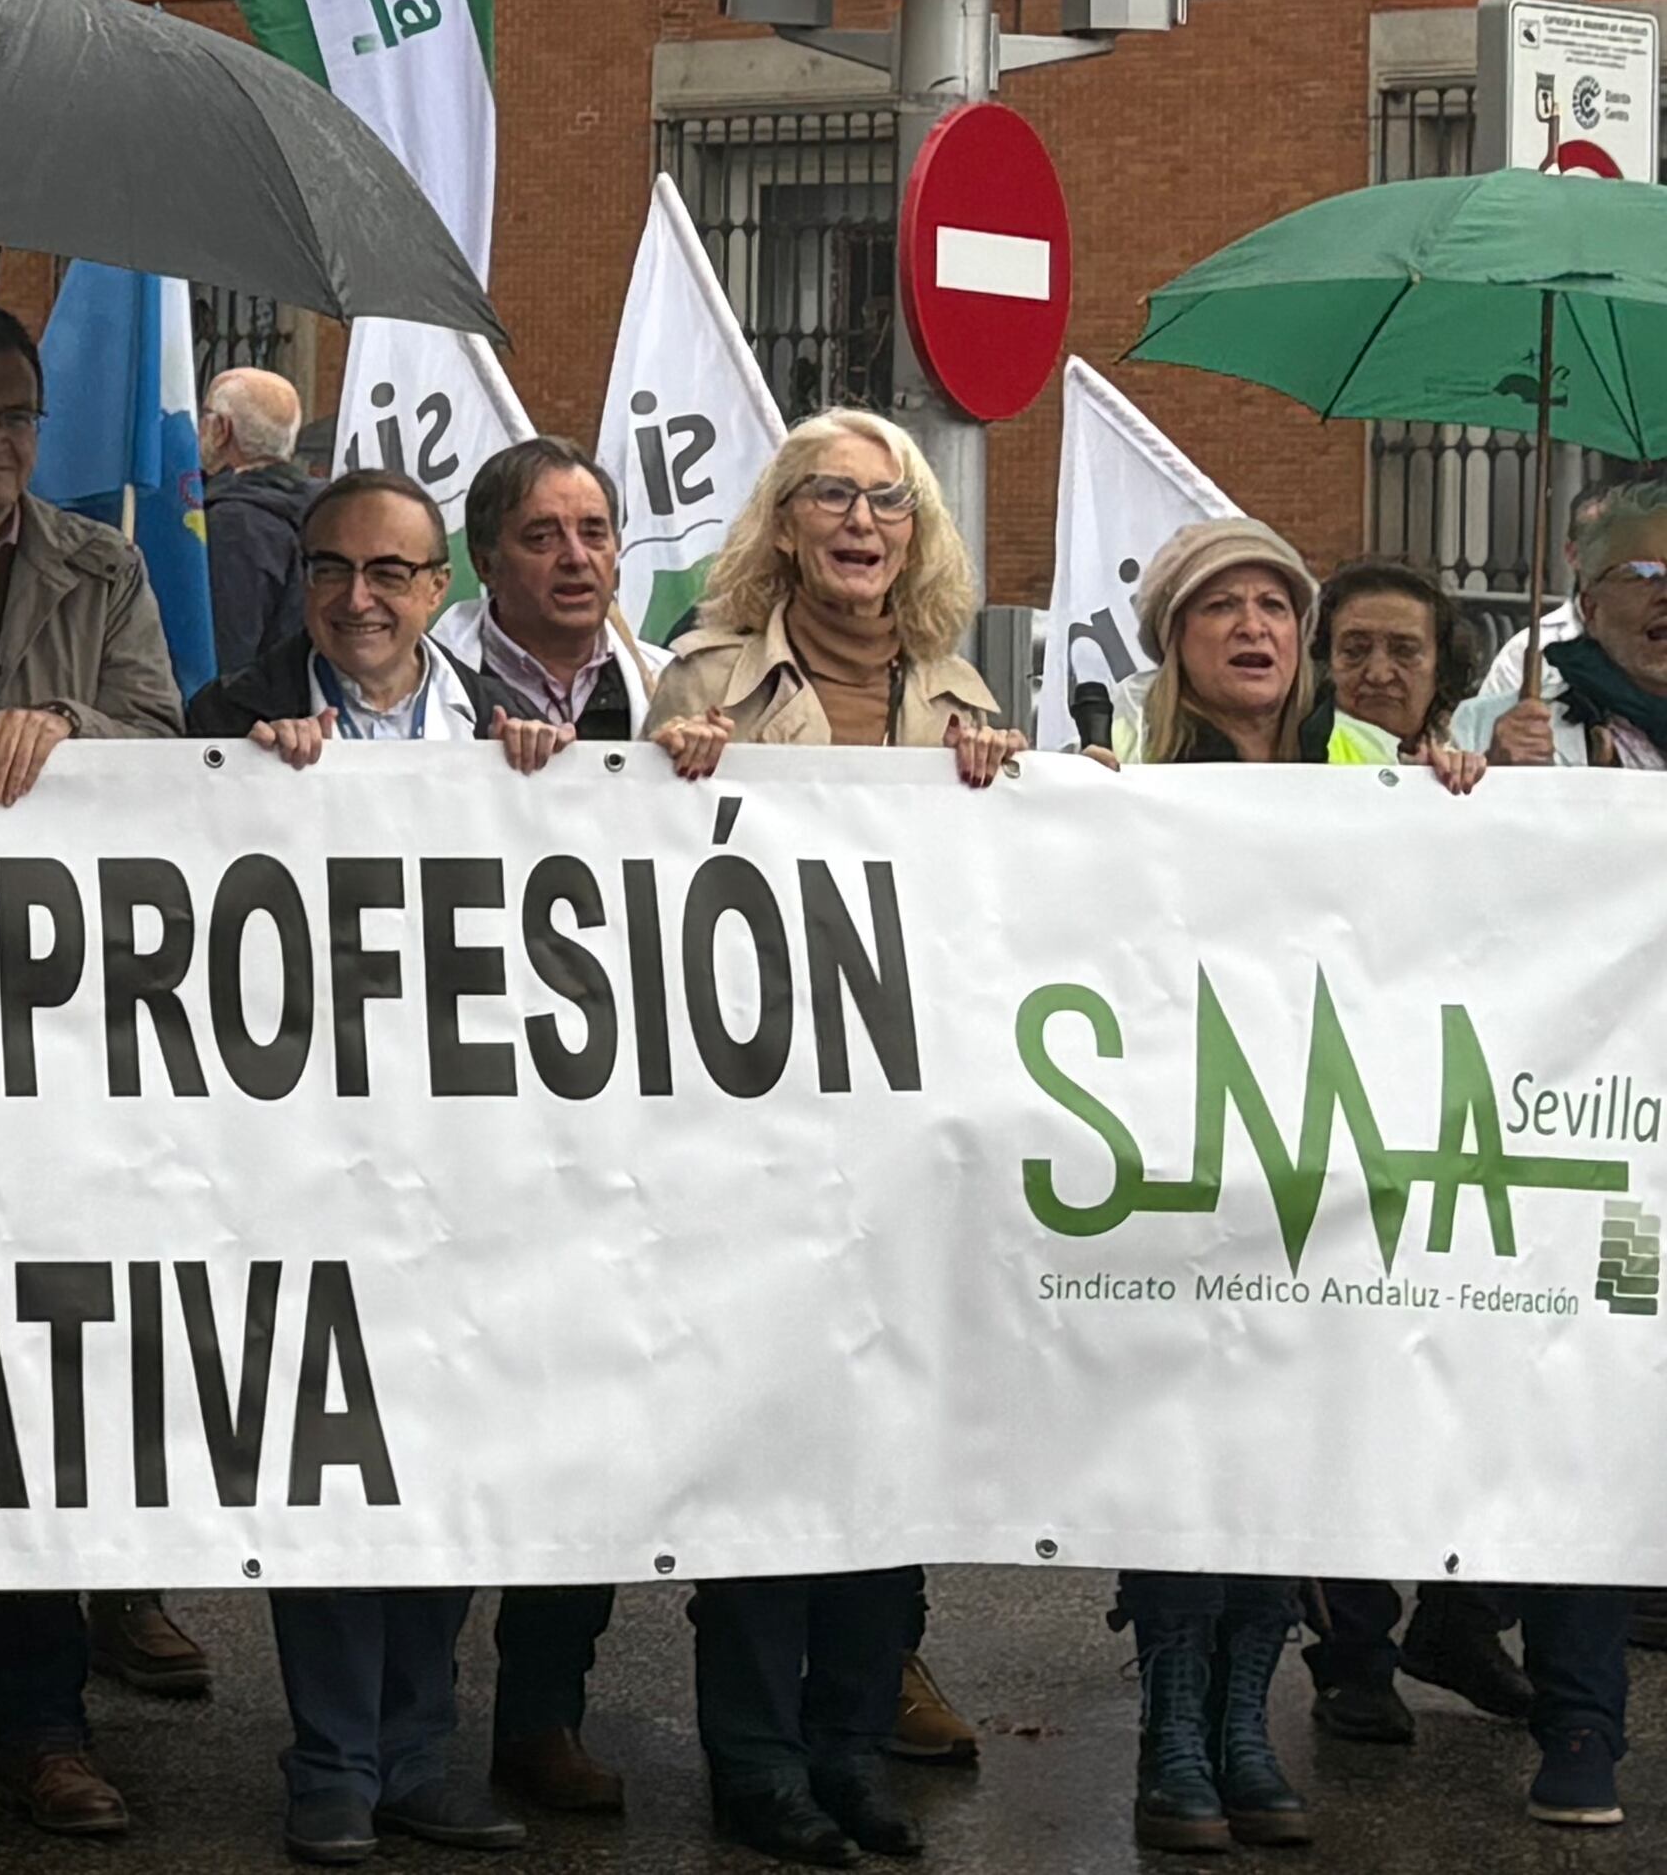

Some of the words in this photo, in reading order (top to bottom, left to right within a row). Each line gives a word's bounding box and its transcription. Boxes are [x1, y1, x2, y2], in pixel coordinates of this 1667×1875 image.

[1016, 959, 1517, 1278] SMA
[1506, 1072, 1662, 1143] Sevilla
[1038, 1273, 1176, 1303] Sindicato
[1195, 1273, 1310, 1306] Médico
[1321, 1278, 1440, 1309] Andaluz
[1459, 1283, 1580, 1316] Federación
